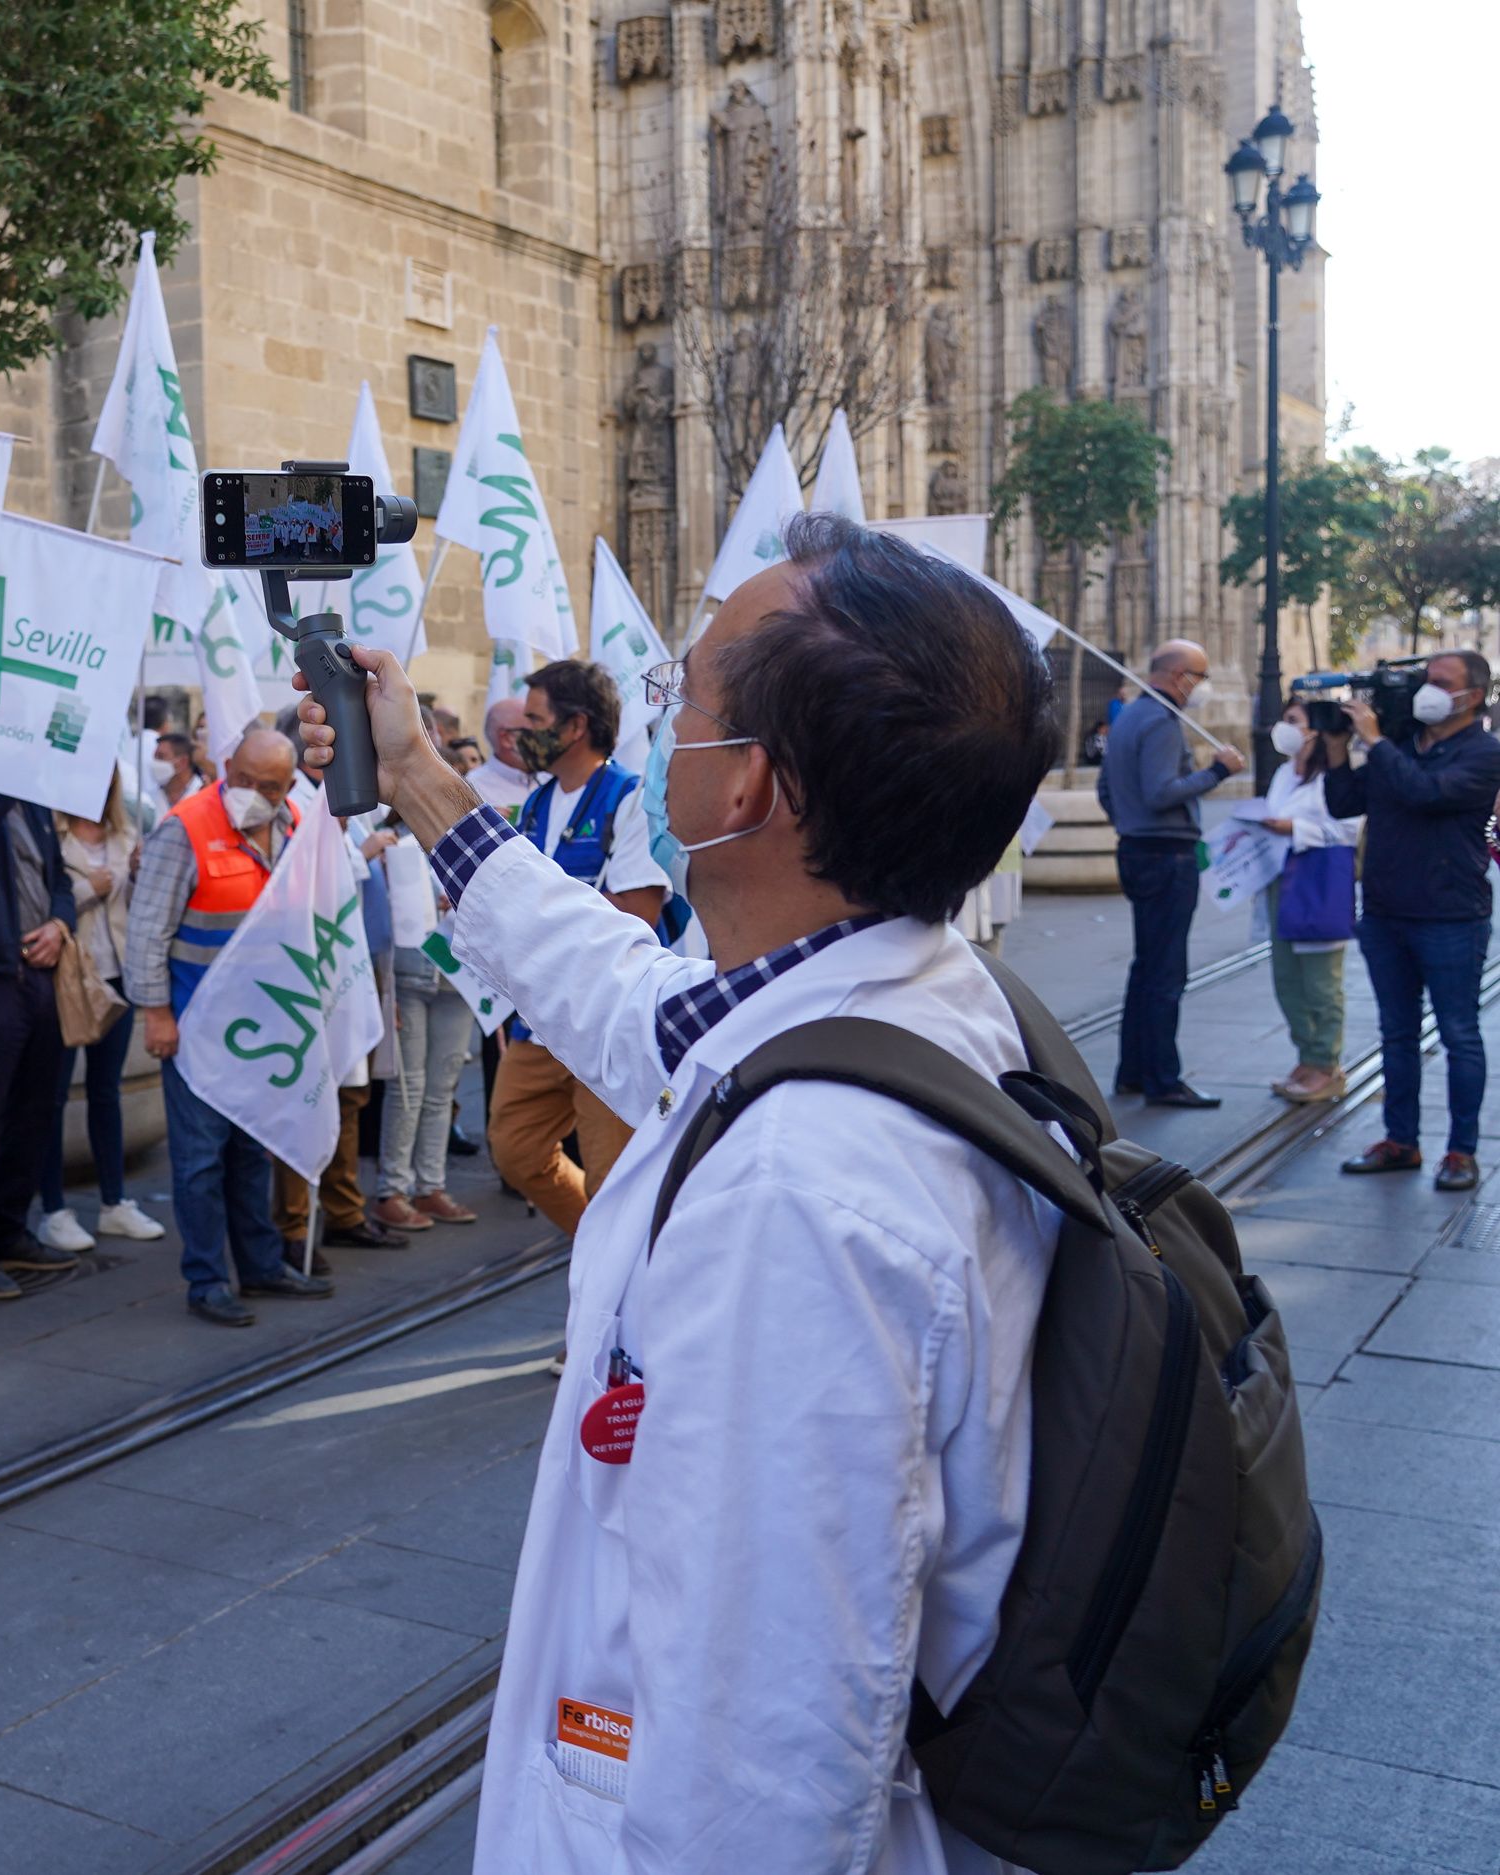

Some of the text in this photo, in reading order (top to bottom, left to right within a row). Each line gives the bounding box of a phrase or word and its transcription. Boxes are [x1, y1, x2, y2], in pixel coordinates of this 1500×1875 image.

[7, 617, 108, 671] Sevilla
[612, 1397, 644, 1410] A IGU
[613, 1427, 635, 1438] IGU
[592, 1440, 633, 1453] RETRIB
[562, 1703, 632, 1739] Ferbiso
